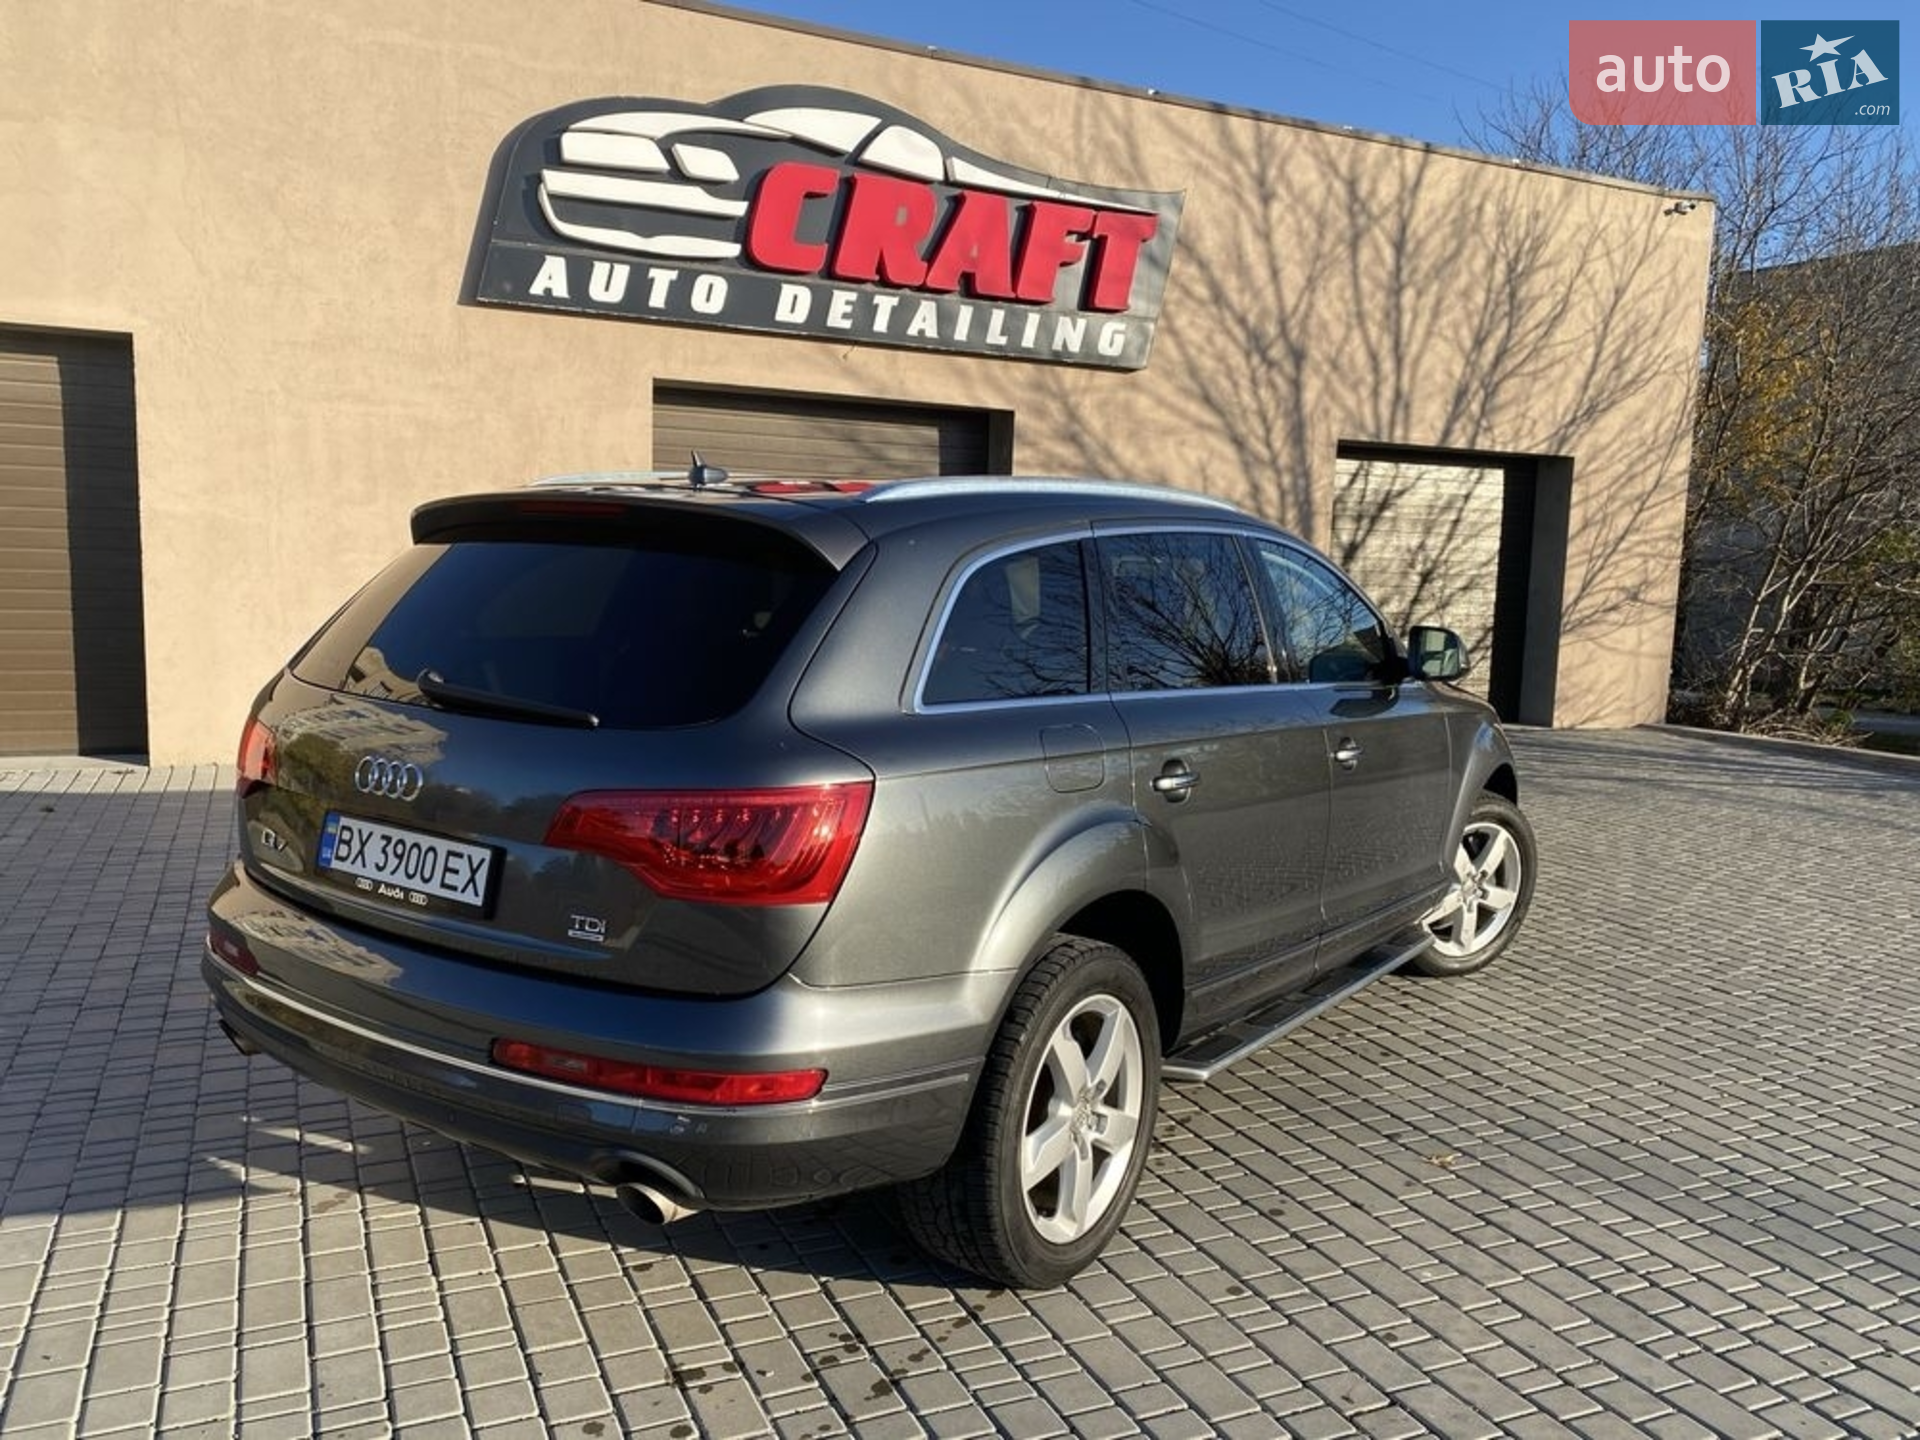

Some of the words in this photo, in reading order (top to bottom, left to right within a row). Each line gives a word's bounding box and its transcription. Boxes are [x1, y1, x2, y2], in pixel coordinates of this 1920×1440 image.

[748, 161, 1158, 311] CRAFT
[528, 255, 729, 314] AUTO
[777, 283, 1128, 356] DETAILING
[335, 825, 373, 868] BX
[375, 834, 438, 884] 3900
[440, 850, 487, 897] EX
[377, 883, 404, 900] Audi
